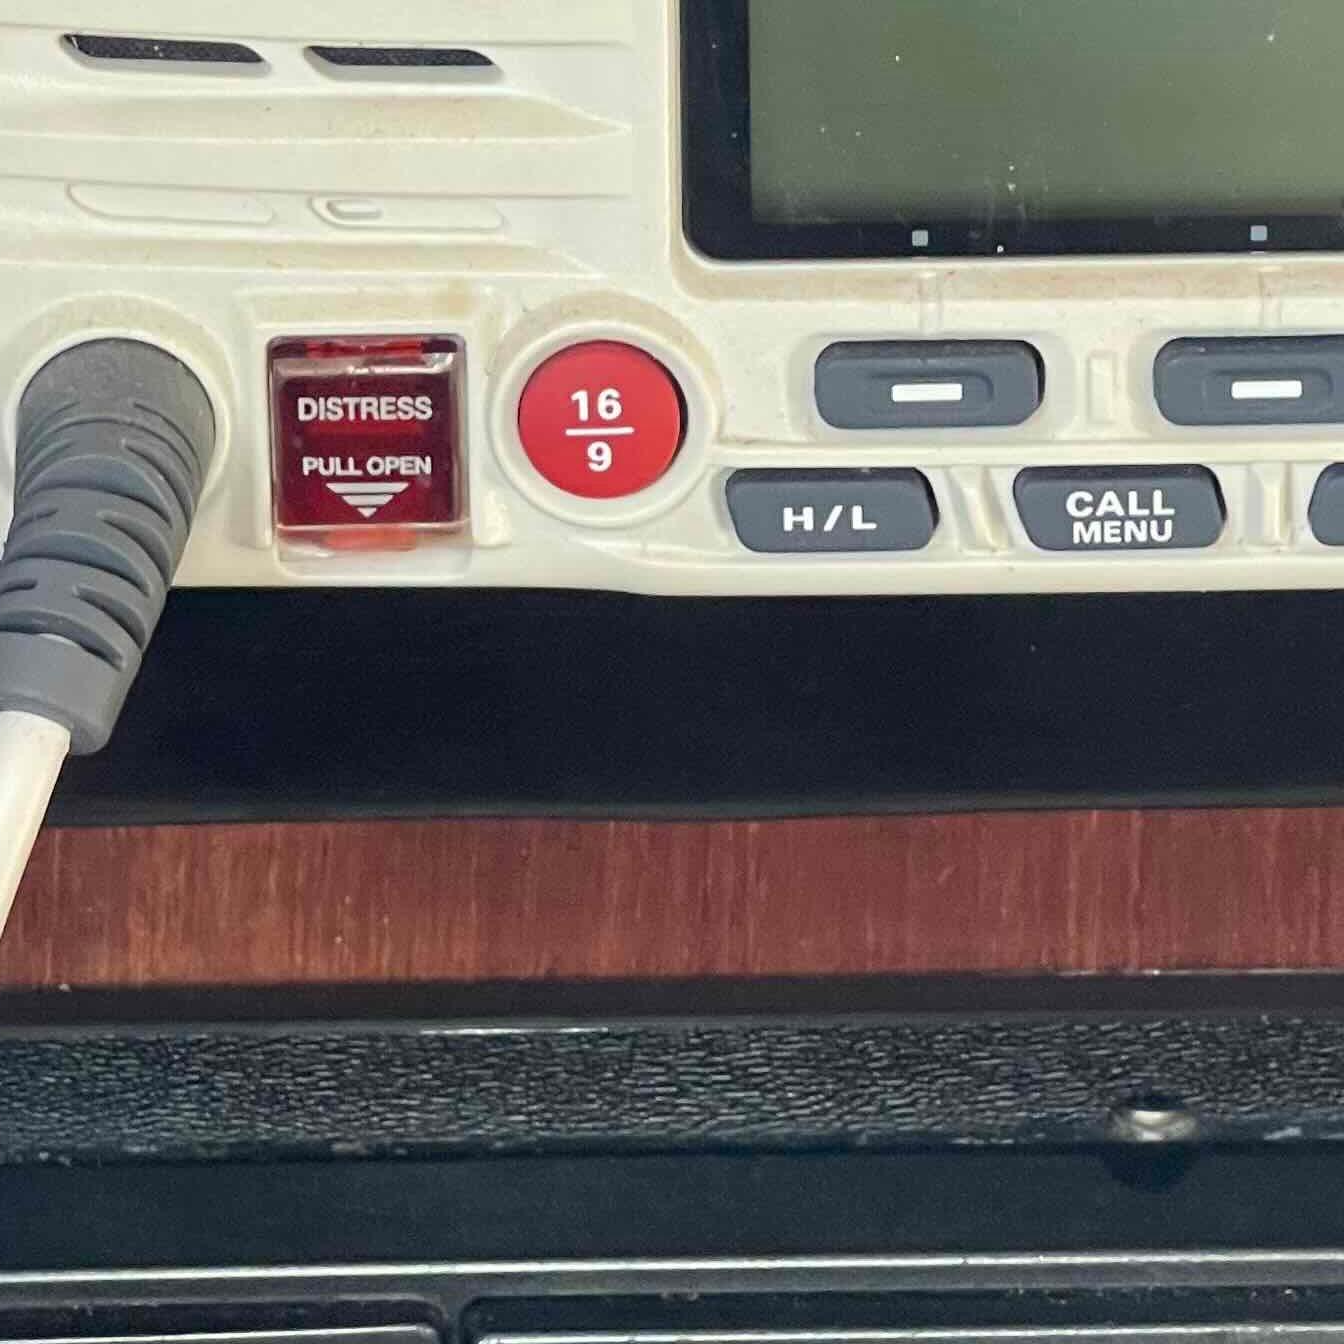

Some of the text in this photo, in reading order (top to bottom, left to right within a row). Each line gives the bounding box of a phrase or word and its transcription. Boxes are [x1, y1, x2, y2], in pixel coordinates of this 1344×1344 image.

[297, 395, 433, 422] DISTRESS
[570, 388, 622, 422] 16
[302, 455, 432, 477] PULL OPEN
[587, 441, 613, 472] 9
[1065, 489, 1175, 518] CALL
[1071, 520, 1174, 544] MENU
